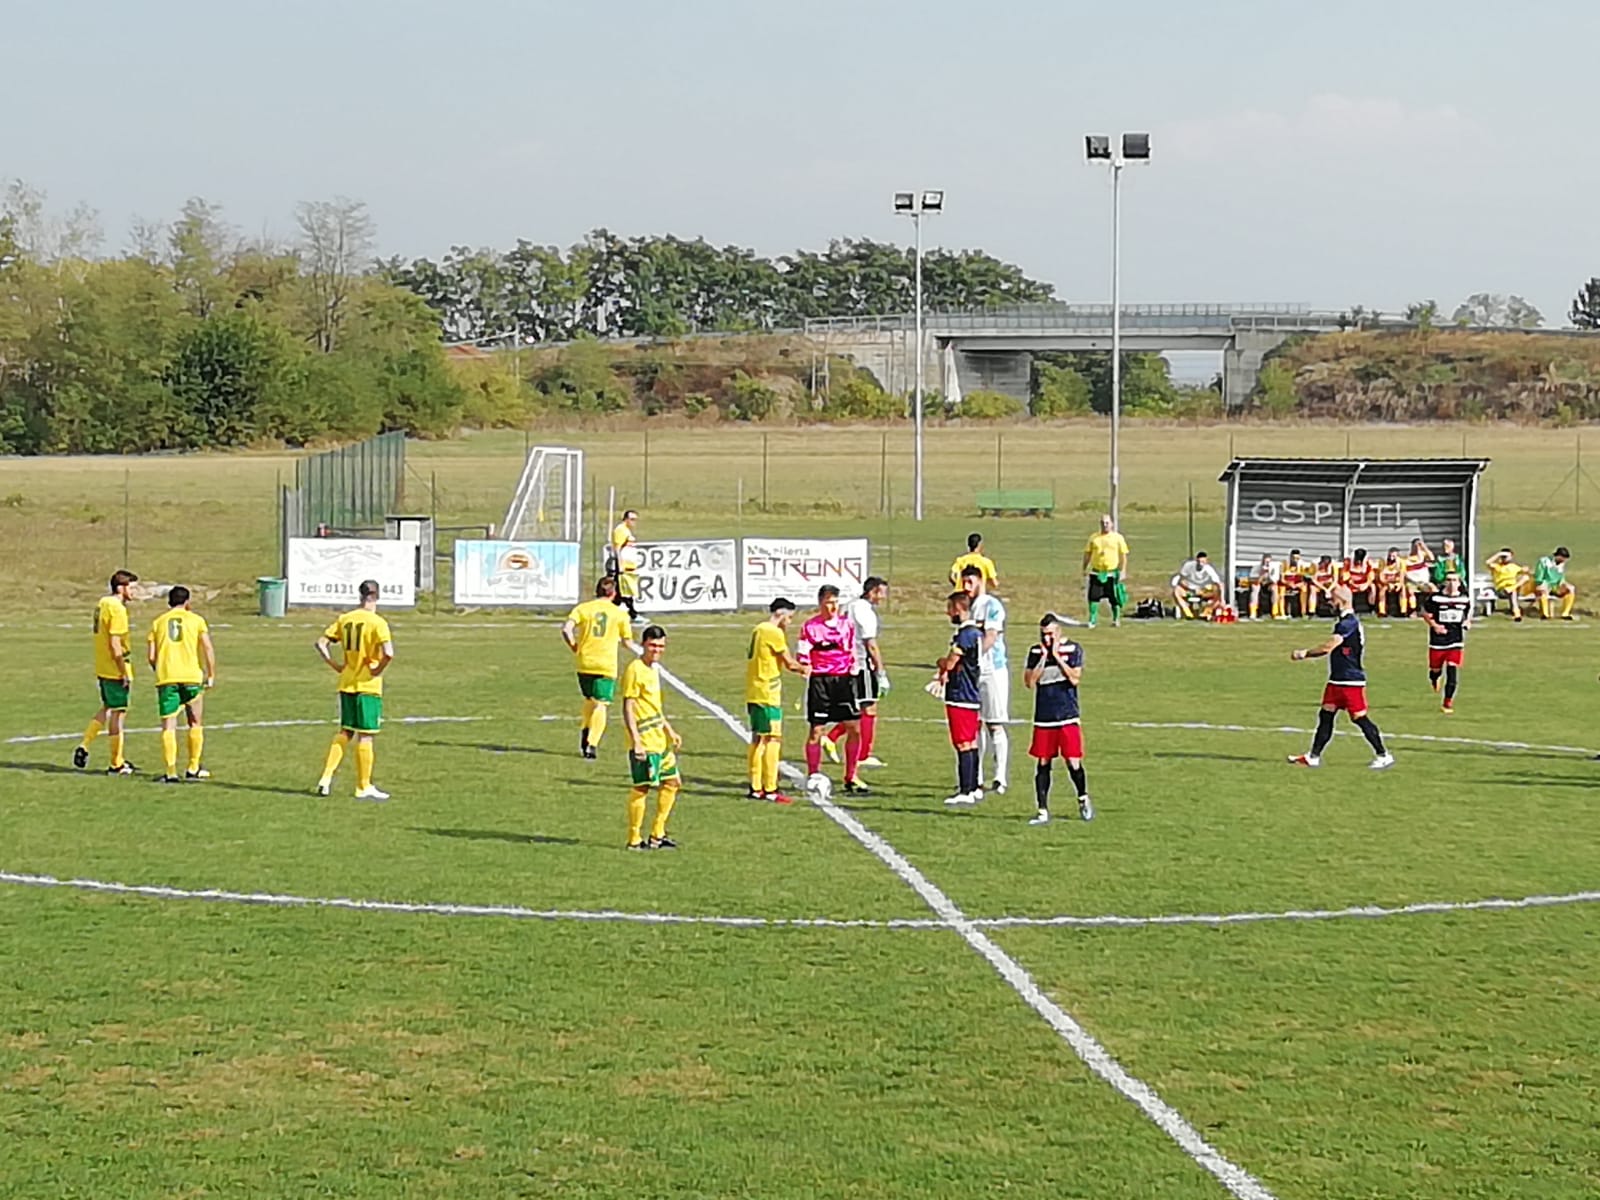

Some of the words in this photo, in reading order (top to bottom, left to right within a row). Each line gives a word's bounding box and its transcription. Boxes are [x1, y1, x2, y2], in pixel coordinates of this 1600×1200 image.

[1252, 499, 1401, 527] OSPITI
[636, 549, 701, 569] ORZA
[748, 556, 862, 584] STRONG
[637, 574, 728, 601] RUGA
[167, 617, 183, 643] 6
[343, 621, 365, 652] 11
